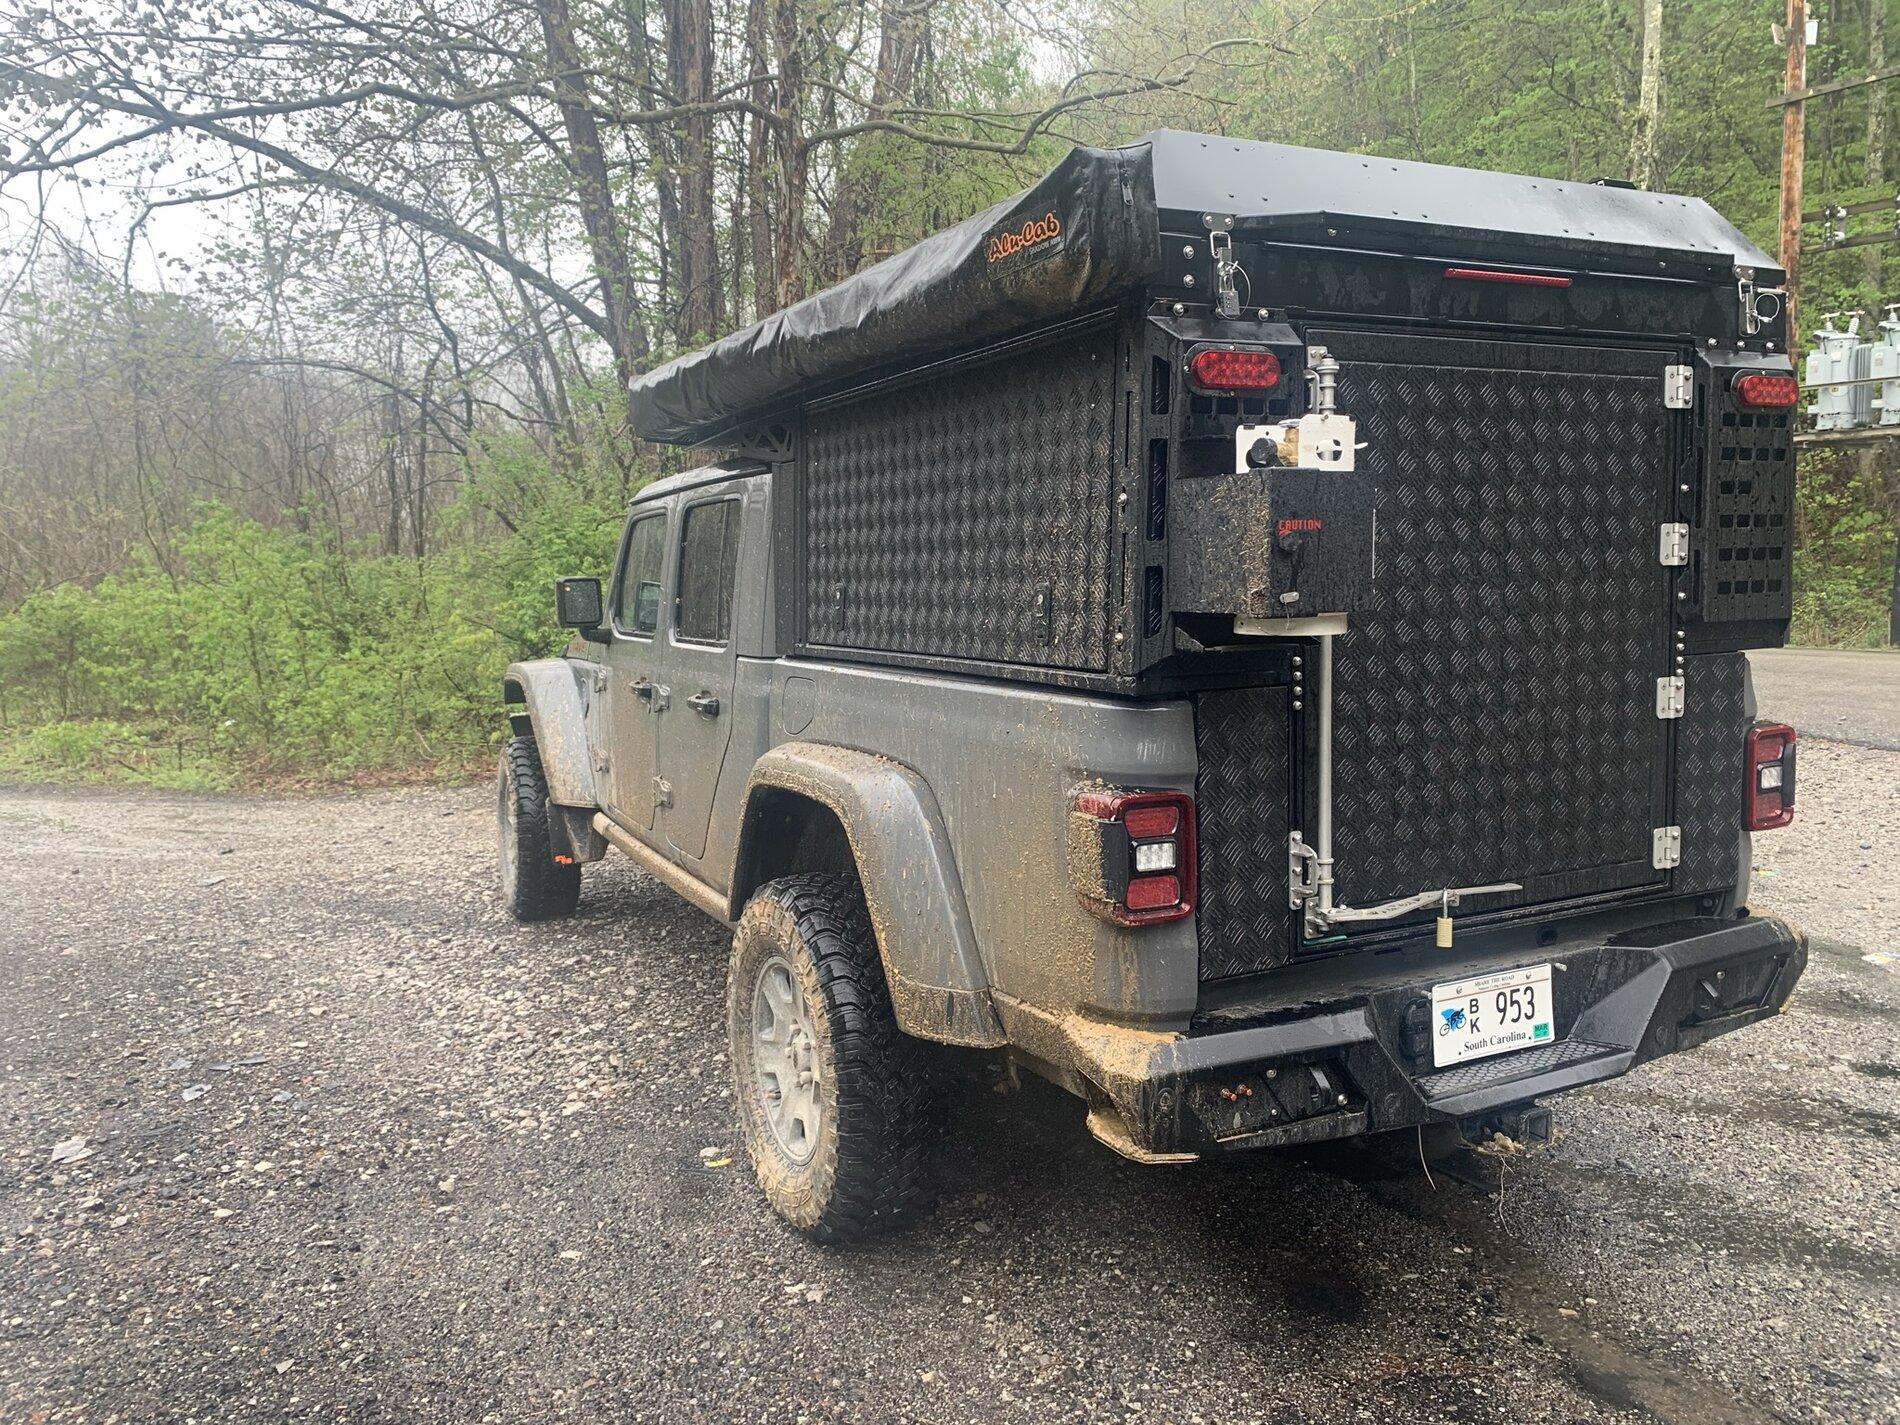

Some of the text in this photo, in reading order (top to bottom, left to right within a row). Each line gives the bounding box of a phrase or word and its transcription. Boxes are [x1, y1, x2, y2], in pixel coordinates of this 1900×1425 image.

[987, 212, 1060, 262] Alu-Cab
[1278, 519, 1322, 531] CAUTION
[1469, 986, 1535, 1026] B 953
[1470, 1017, 1481, 1034] K
[1464, 1037, 1488, 1052] South
[1490, 1031, 1526, 1046] Carolina
